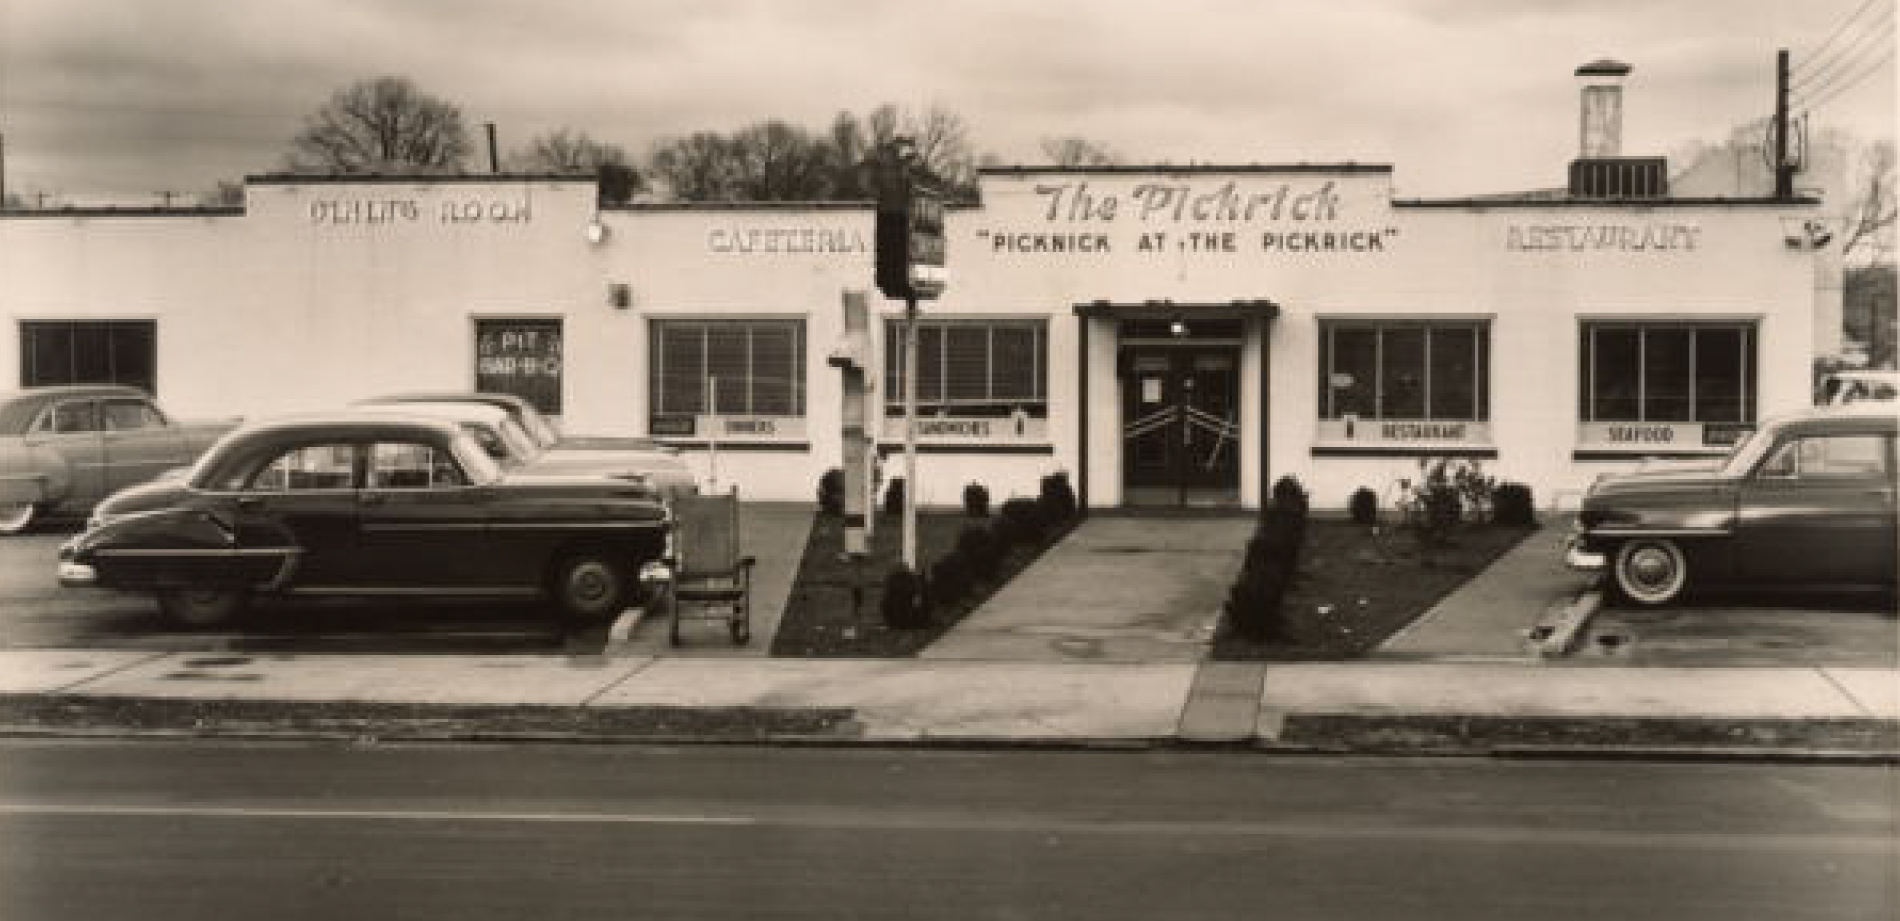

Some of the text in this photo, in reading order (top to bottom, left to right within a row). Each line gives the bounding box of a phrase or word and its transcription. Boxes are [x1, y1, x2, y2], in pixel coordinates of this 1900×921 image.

[1034, 181, 1340, 222] The Pickrick
[707, 228, 867, 253] CAFETERIA
[976, 226, 1398, 252] "PICKNICK AT THE PICKRICK"
[1506, 226, 1701, 252] RESTAURANT
[502, 331, 539, 351] PIT
[1608, 426, 1674, 442] SEAFOOD
